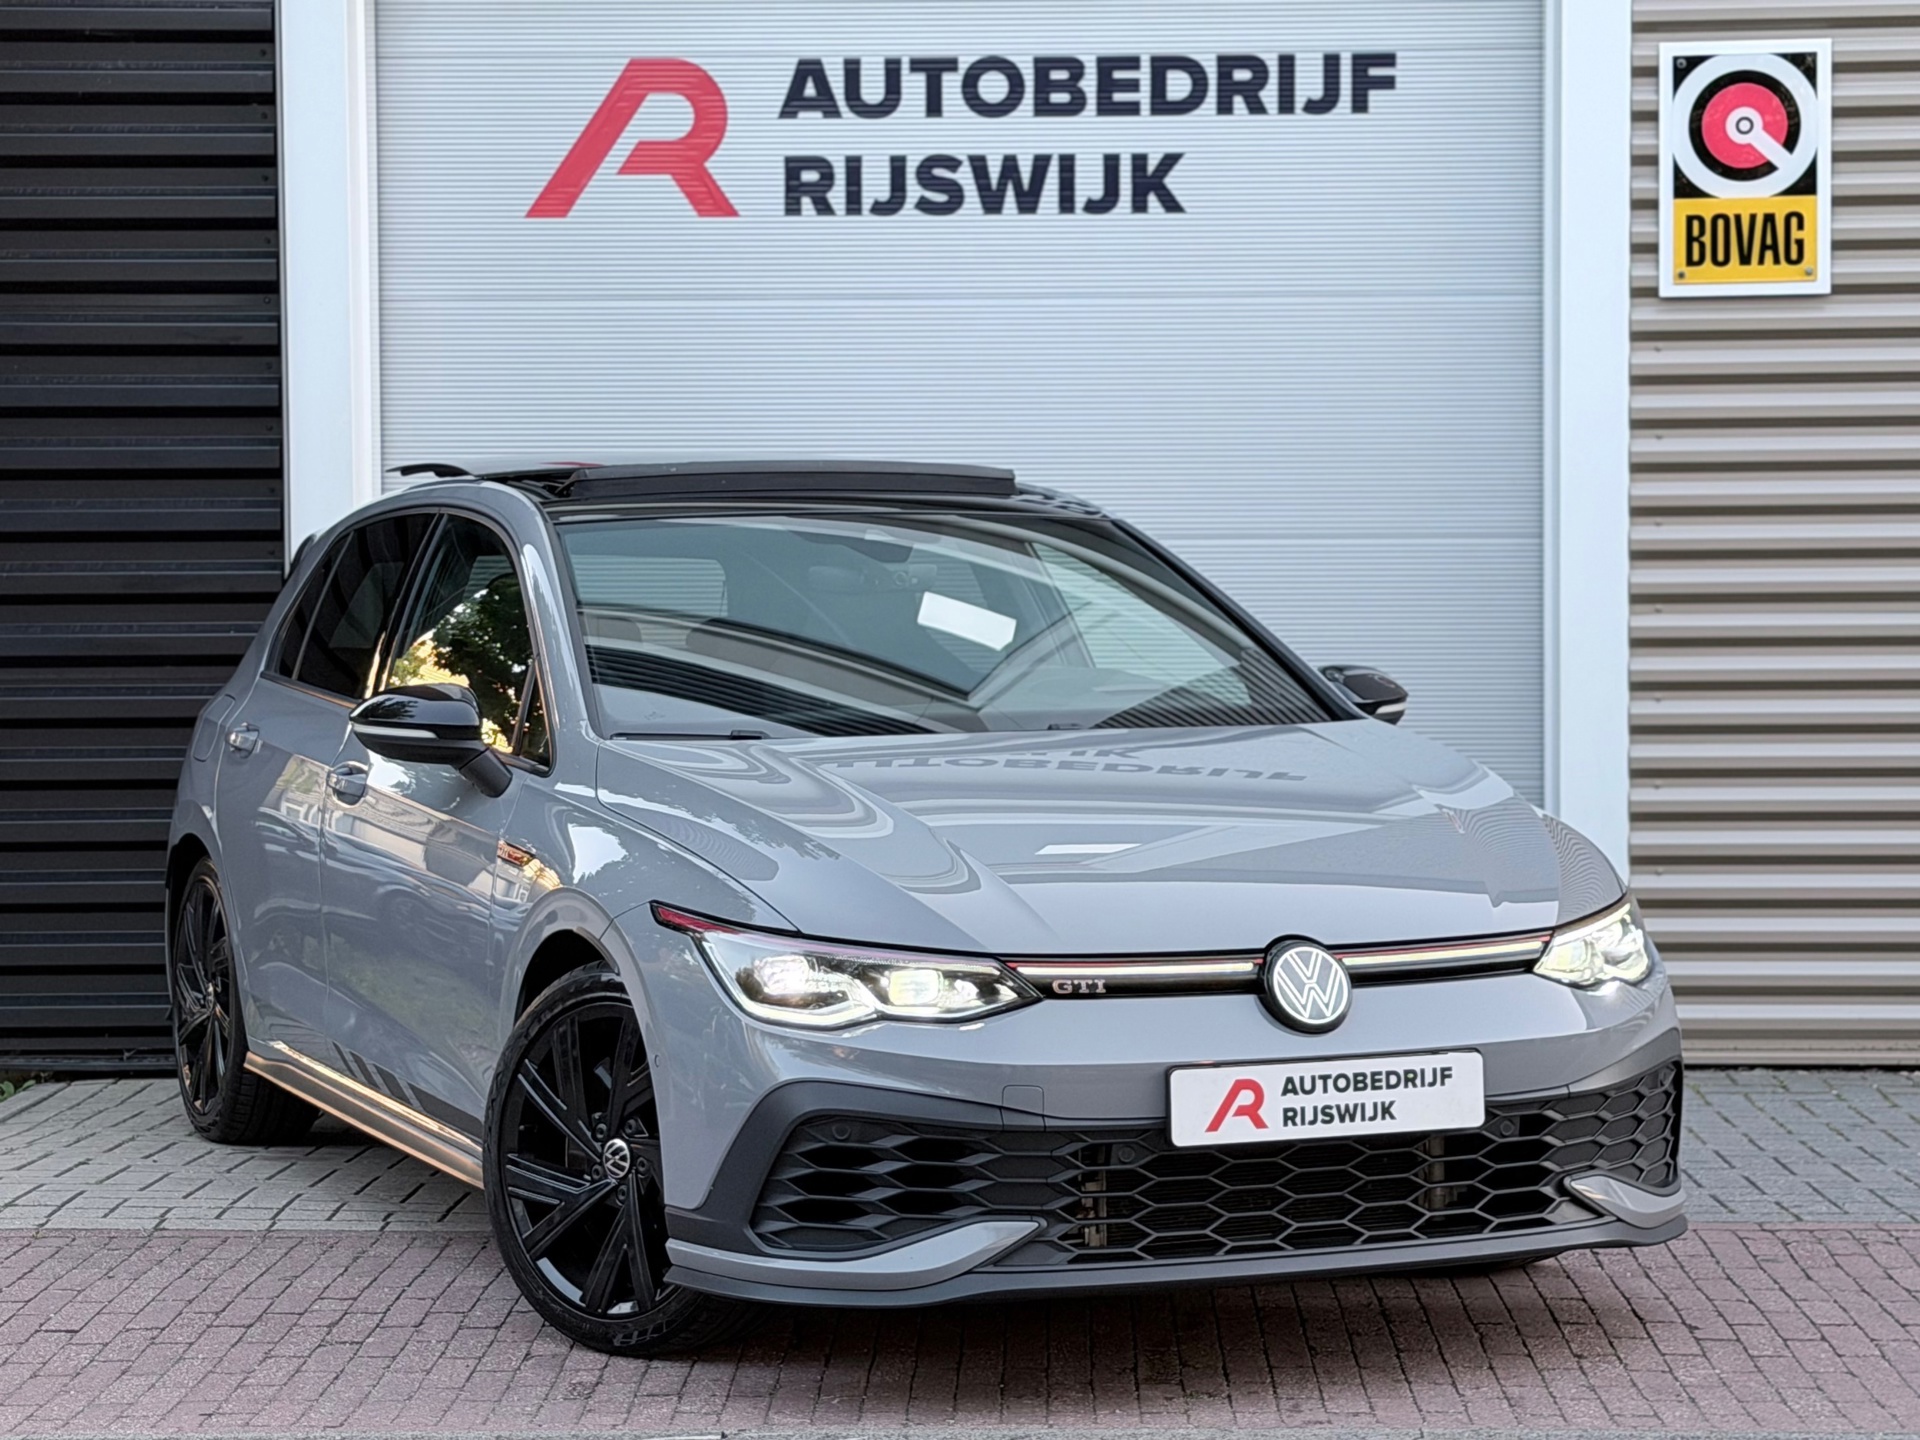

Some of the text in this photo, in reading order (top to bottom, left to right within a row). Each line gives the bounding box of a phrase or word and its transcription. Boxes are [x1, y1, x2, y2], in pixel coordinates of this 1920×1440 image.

[779, 52, 1397, 119] AUTOBEDRIJF
[784, 152, 1187, 217] RIJSWIJK
[1685, 211, 1805, 267] BOVAG
[1052, 979, 1107, 995] GTI
[1280, 1065, 1453, 1097] AUTOBEDRIJF
[1282, 1099, 1397, 1128] RIJSWIJK
